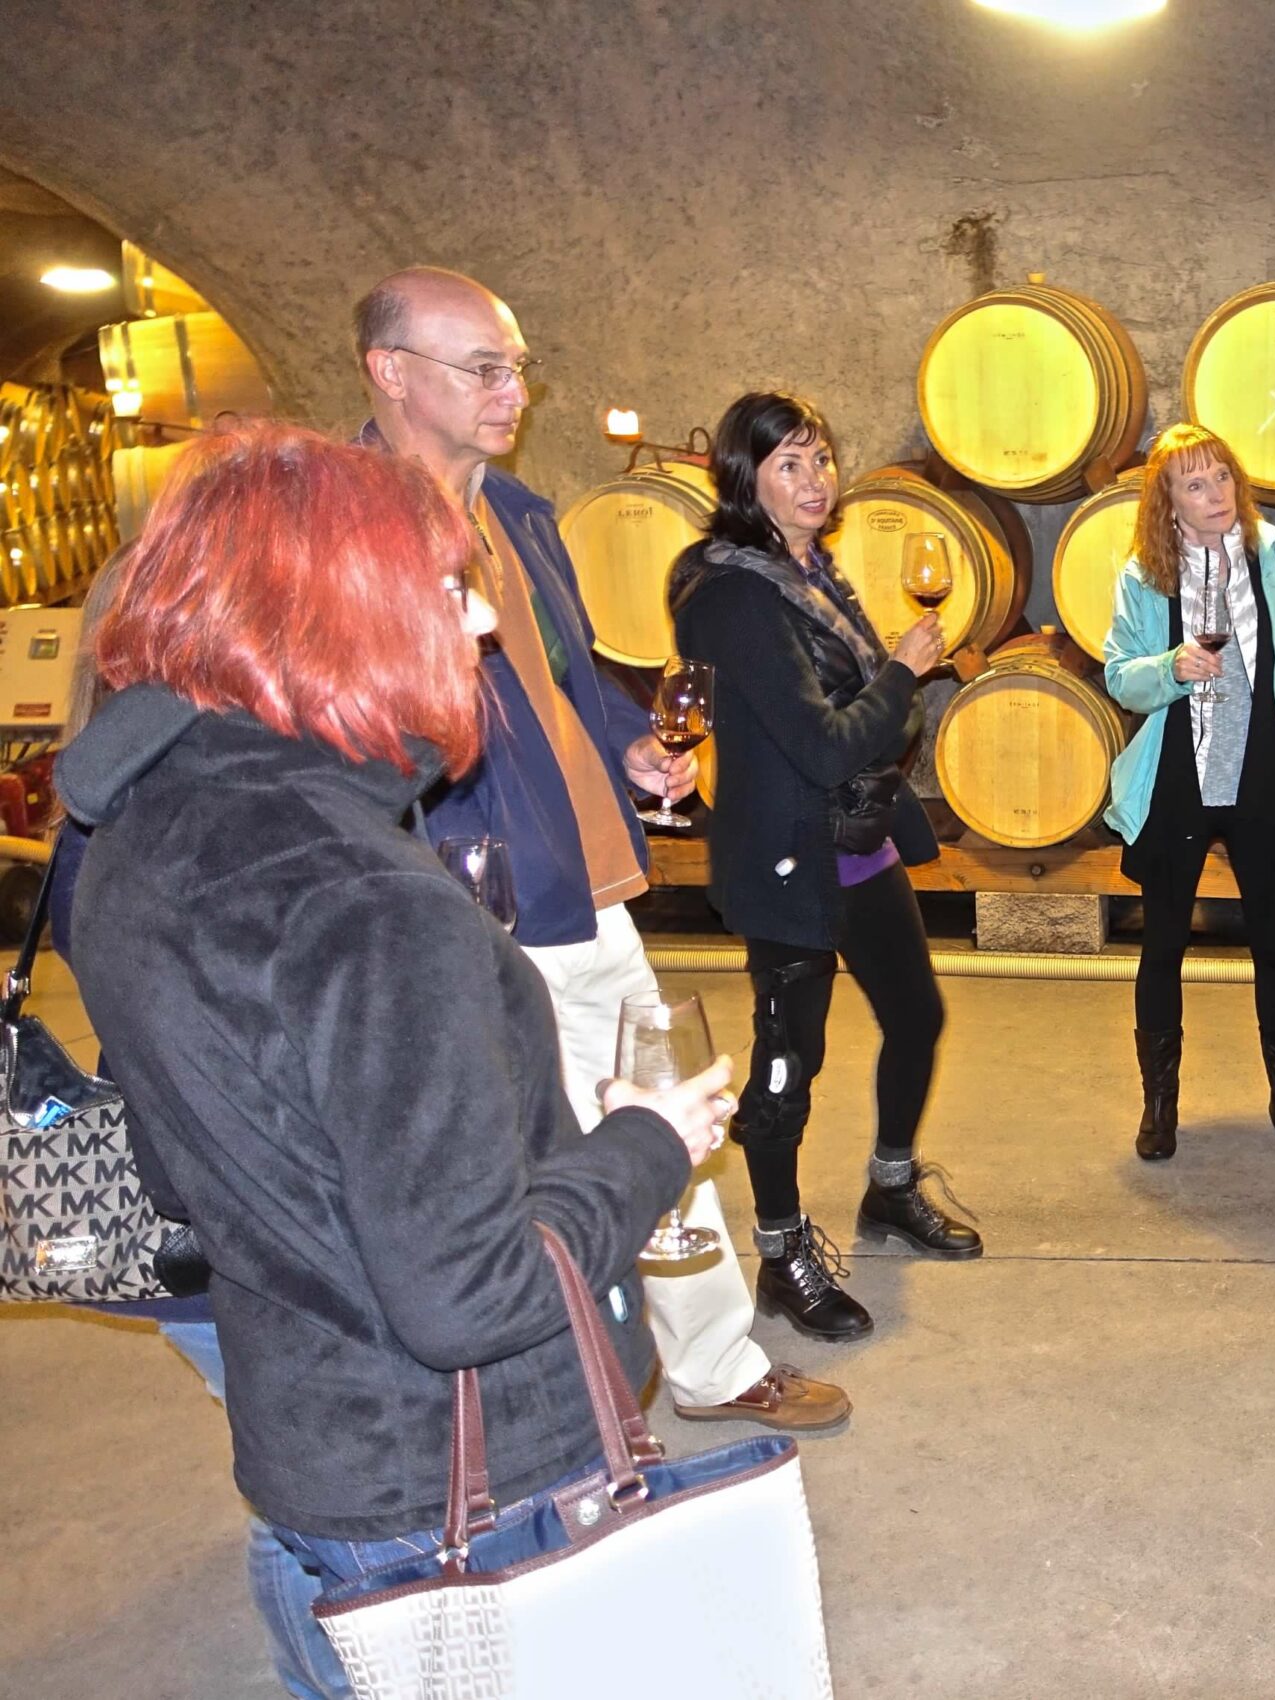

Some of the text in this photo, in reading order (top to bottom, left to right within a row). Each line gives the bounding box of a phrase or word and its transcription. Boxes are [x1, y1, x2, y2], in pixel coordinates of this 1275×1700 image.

[7, 1130, 119, 1160] MK MK
[35, 1161, 88, 1189] MK
[3, 1193, 55, 1219] MK
[61, 1188, 113, 1217] MK
[89, 1211, 136, 1242] MK
[113, 1231, 157, 1267] MK
[27, 1278, 81, 1298] MK
[84, 1267, 138, 1298] MK
